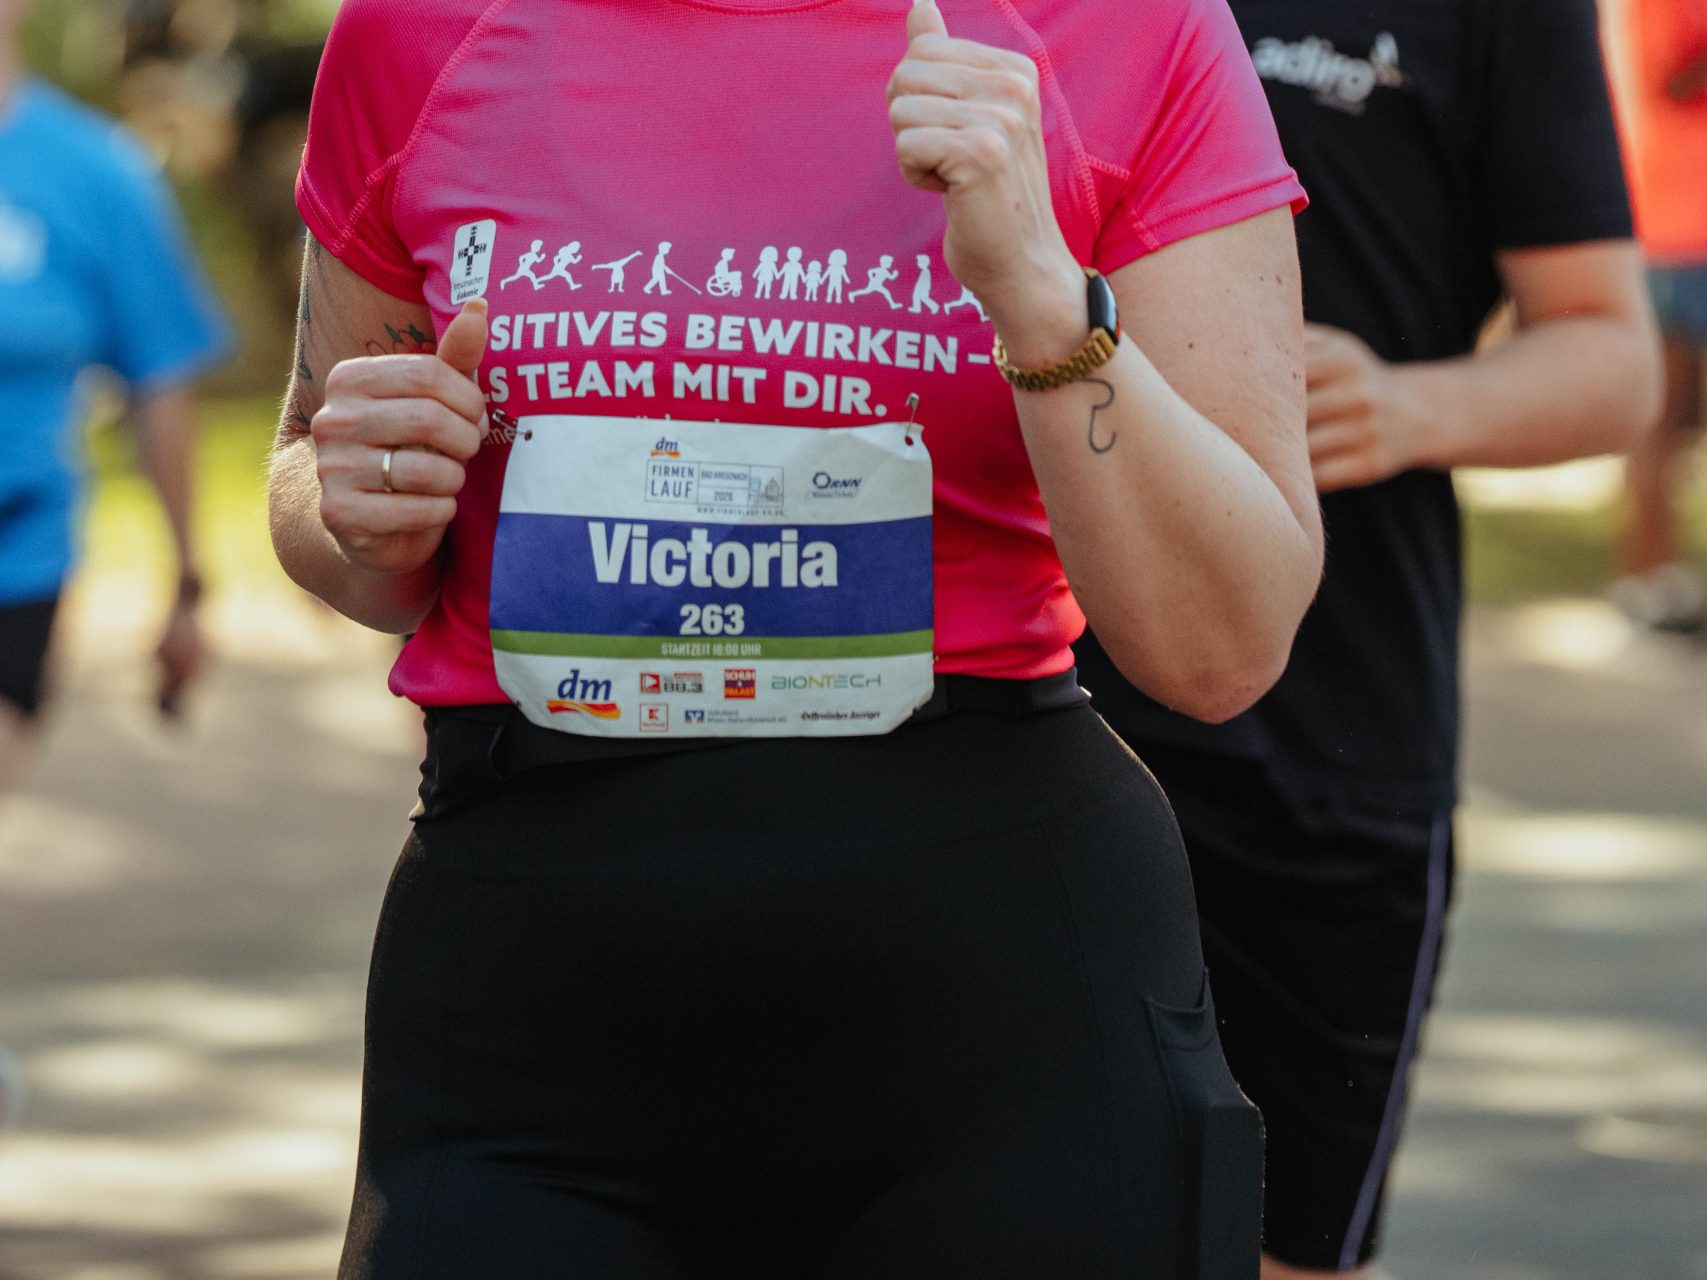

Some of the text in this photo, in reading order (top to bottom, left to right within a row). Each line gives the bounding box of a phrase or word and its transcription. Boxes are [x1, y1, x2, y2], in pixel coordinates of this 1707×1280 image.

[490, 311, 668, 351] SITIVES
[685, 313, 958, 374] BEWIRKEN
[517, 360, 656, 401] TEAM
[673, 362, 767, 404] MIT
[783, 370, 888, 417] DIR.
[655, 437, 678, 451] dm
[651, 465, 695, 478] FIRMEN
[650, 479, 693, 498] LAUF
[587, 521, 839, 589] Victoria
[680, 603, 745, 636] 263
[661, 642, 711, 657] STARTZEIT
[740, 642, 762, 657] UHR
[557, 668, 613, 701] dm
[771, 673, 882, 690] BIONTECH
